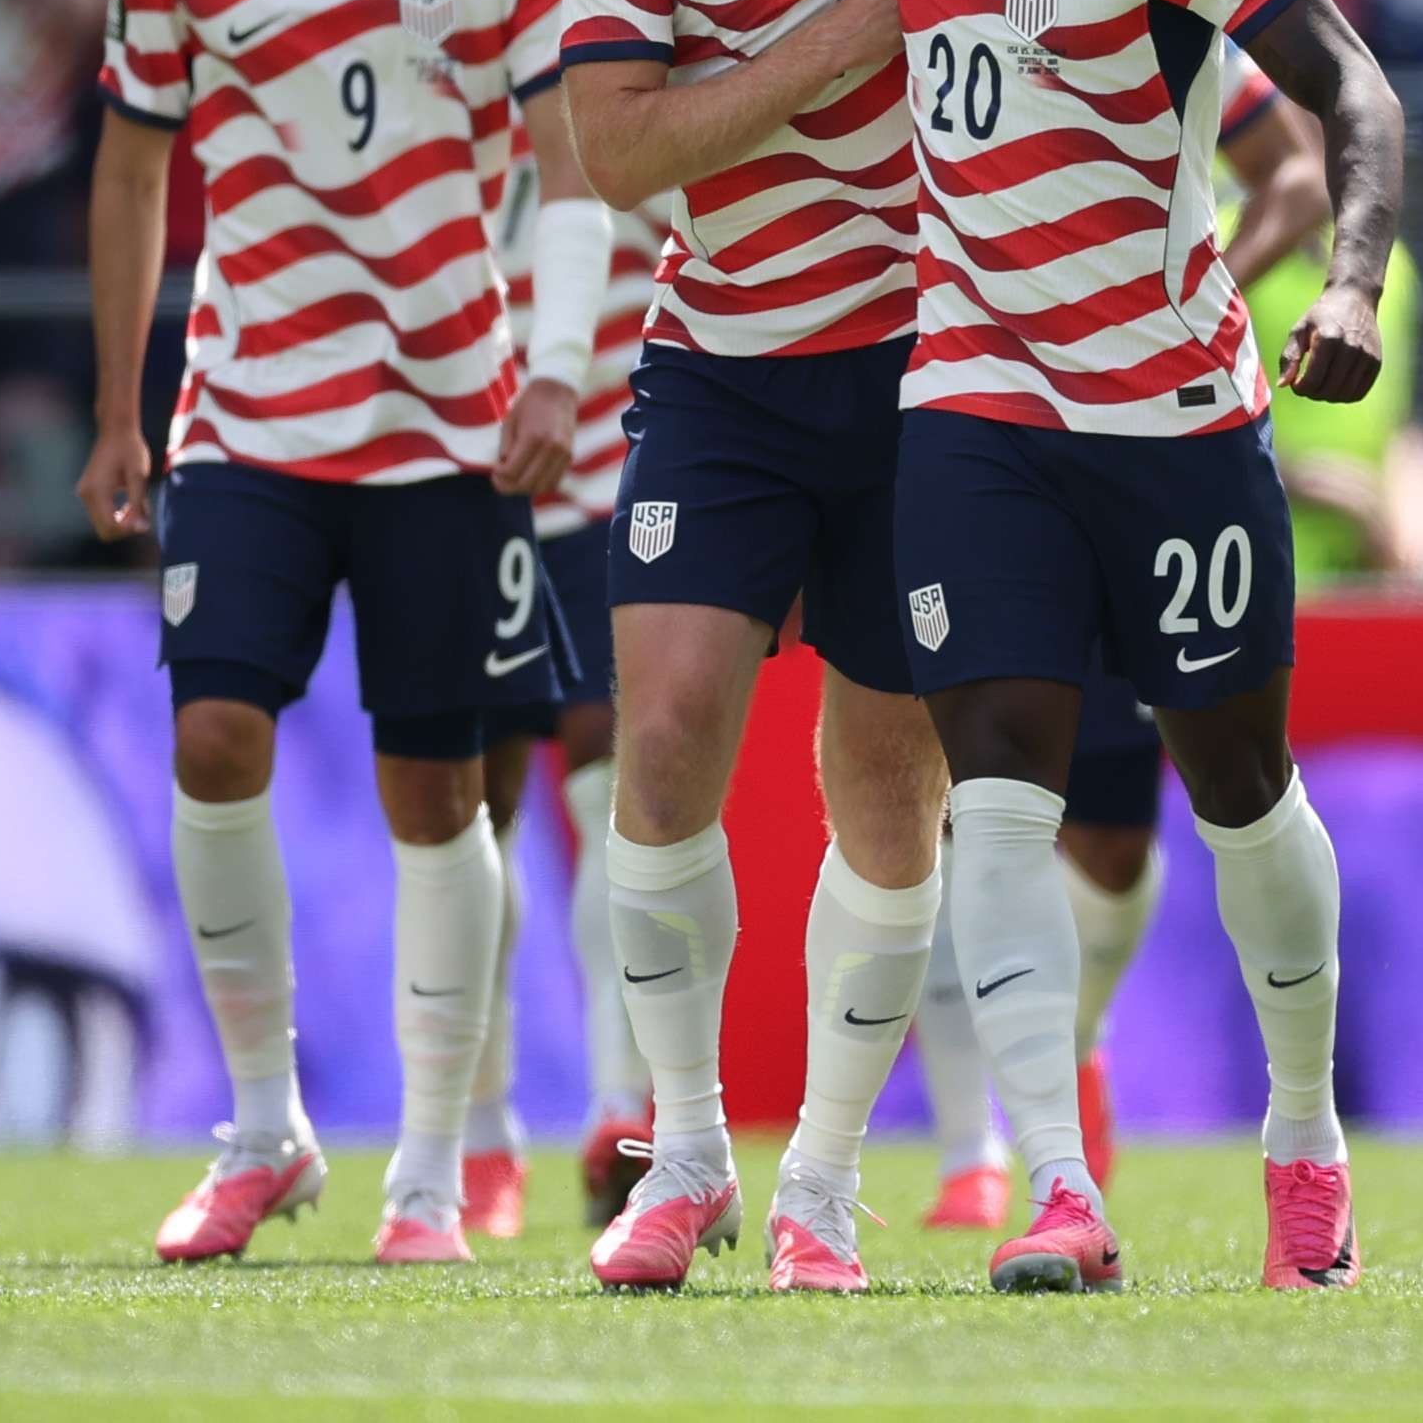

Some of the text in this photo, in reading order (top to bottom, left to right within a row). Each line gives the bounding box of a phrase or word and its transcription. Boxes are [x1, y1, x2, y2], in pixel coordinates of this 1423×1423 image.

[341, 61, 376, 153] 9
[927, 33, 1002, 140] 20
[634, 505, 674, 528] USA
[495, 536, 534, 640] 9
[911, 587, 941, 615] USA
[1154, 524, 1253, 635] 20
